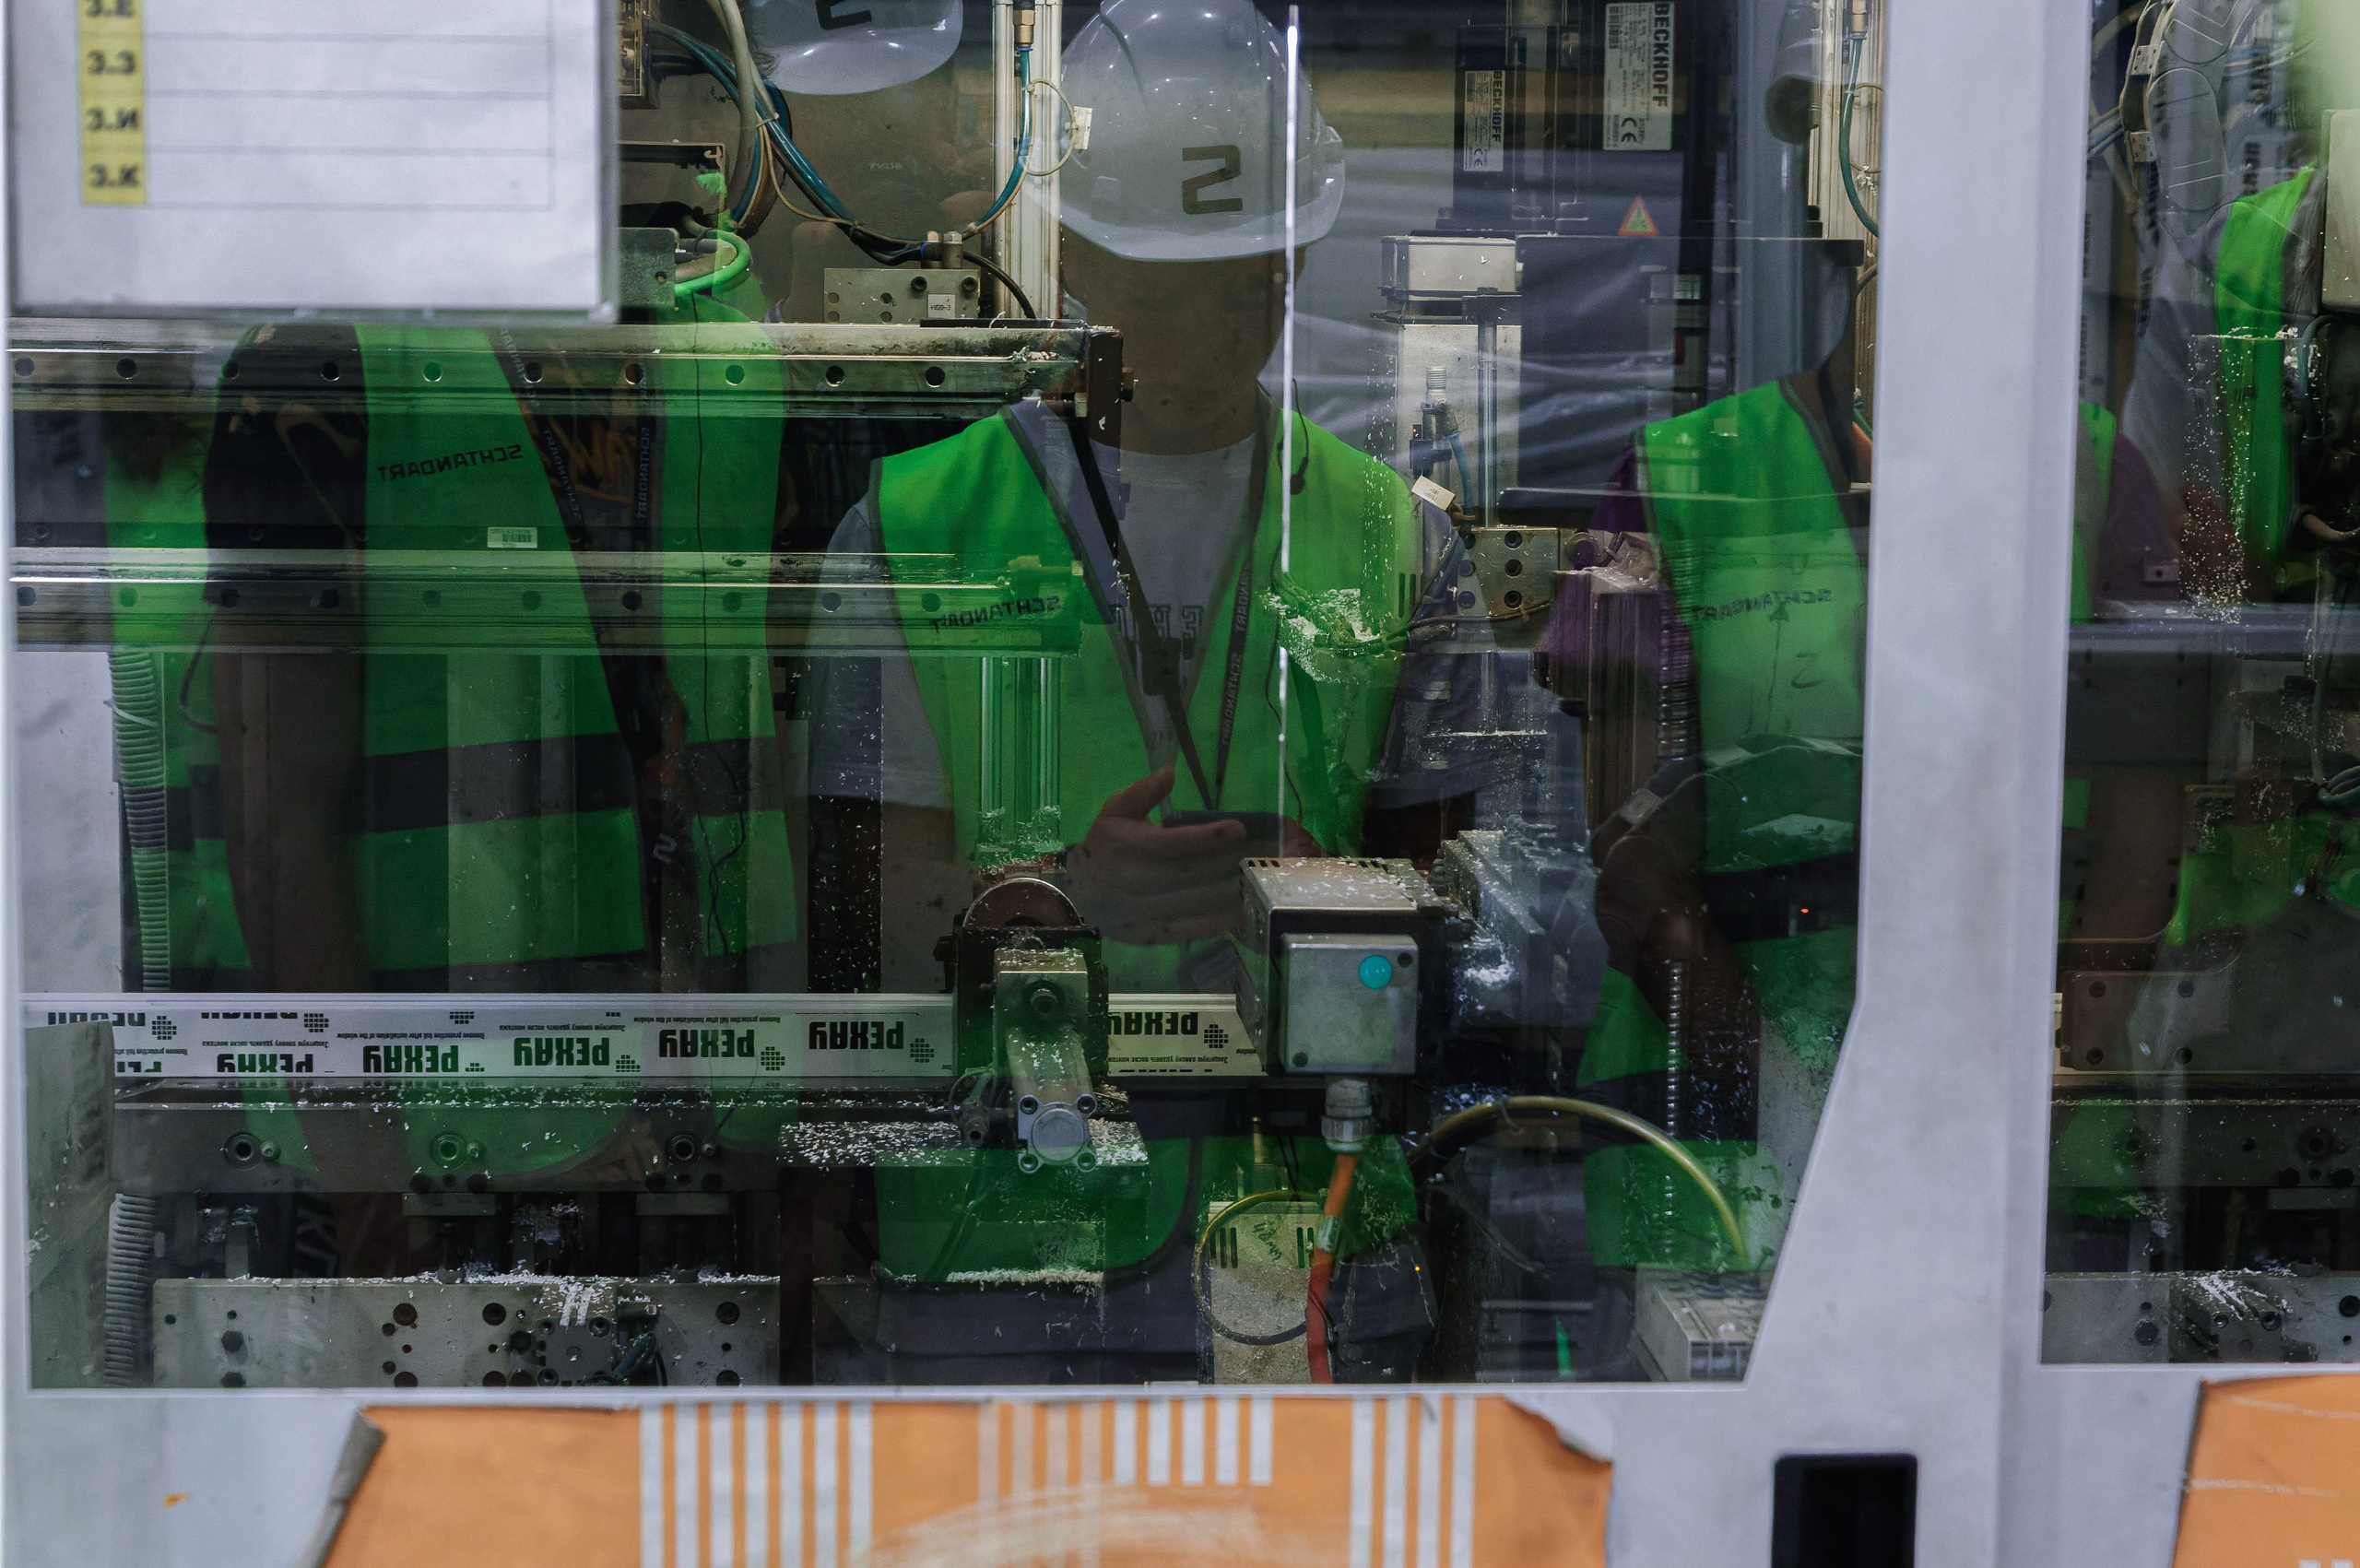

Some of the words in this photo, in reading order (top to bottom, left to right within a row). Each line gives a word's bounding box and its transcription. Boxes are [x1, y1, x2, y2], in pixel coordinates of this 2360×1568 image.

[1653, 3, 1670, 107] BECKHOFF
[1492, 70, 1503, 143] BECKHOFF
[658, 1030, 754, 1057] РЕХАУ
[808, 1021, 903, 1050] РЕХАУ
[362, 1045, 459, 1073] РЕХАУ
[513, 1037, 609, 1066] РЕХАУ
